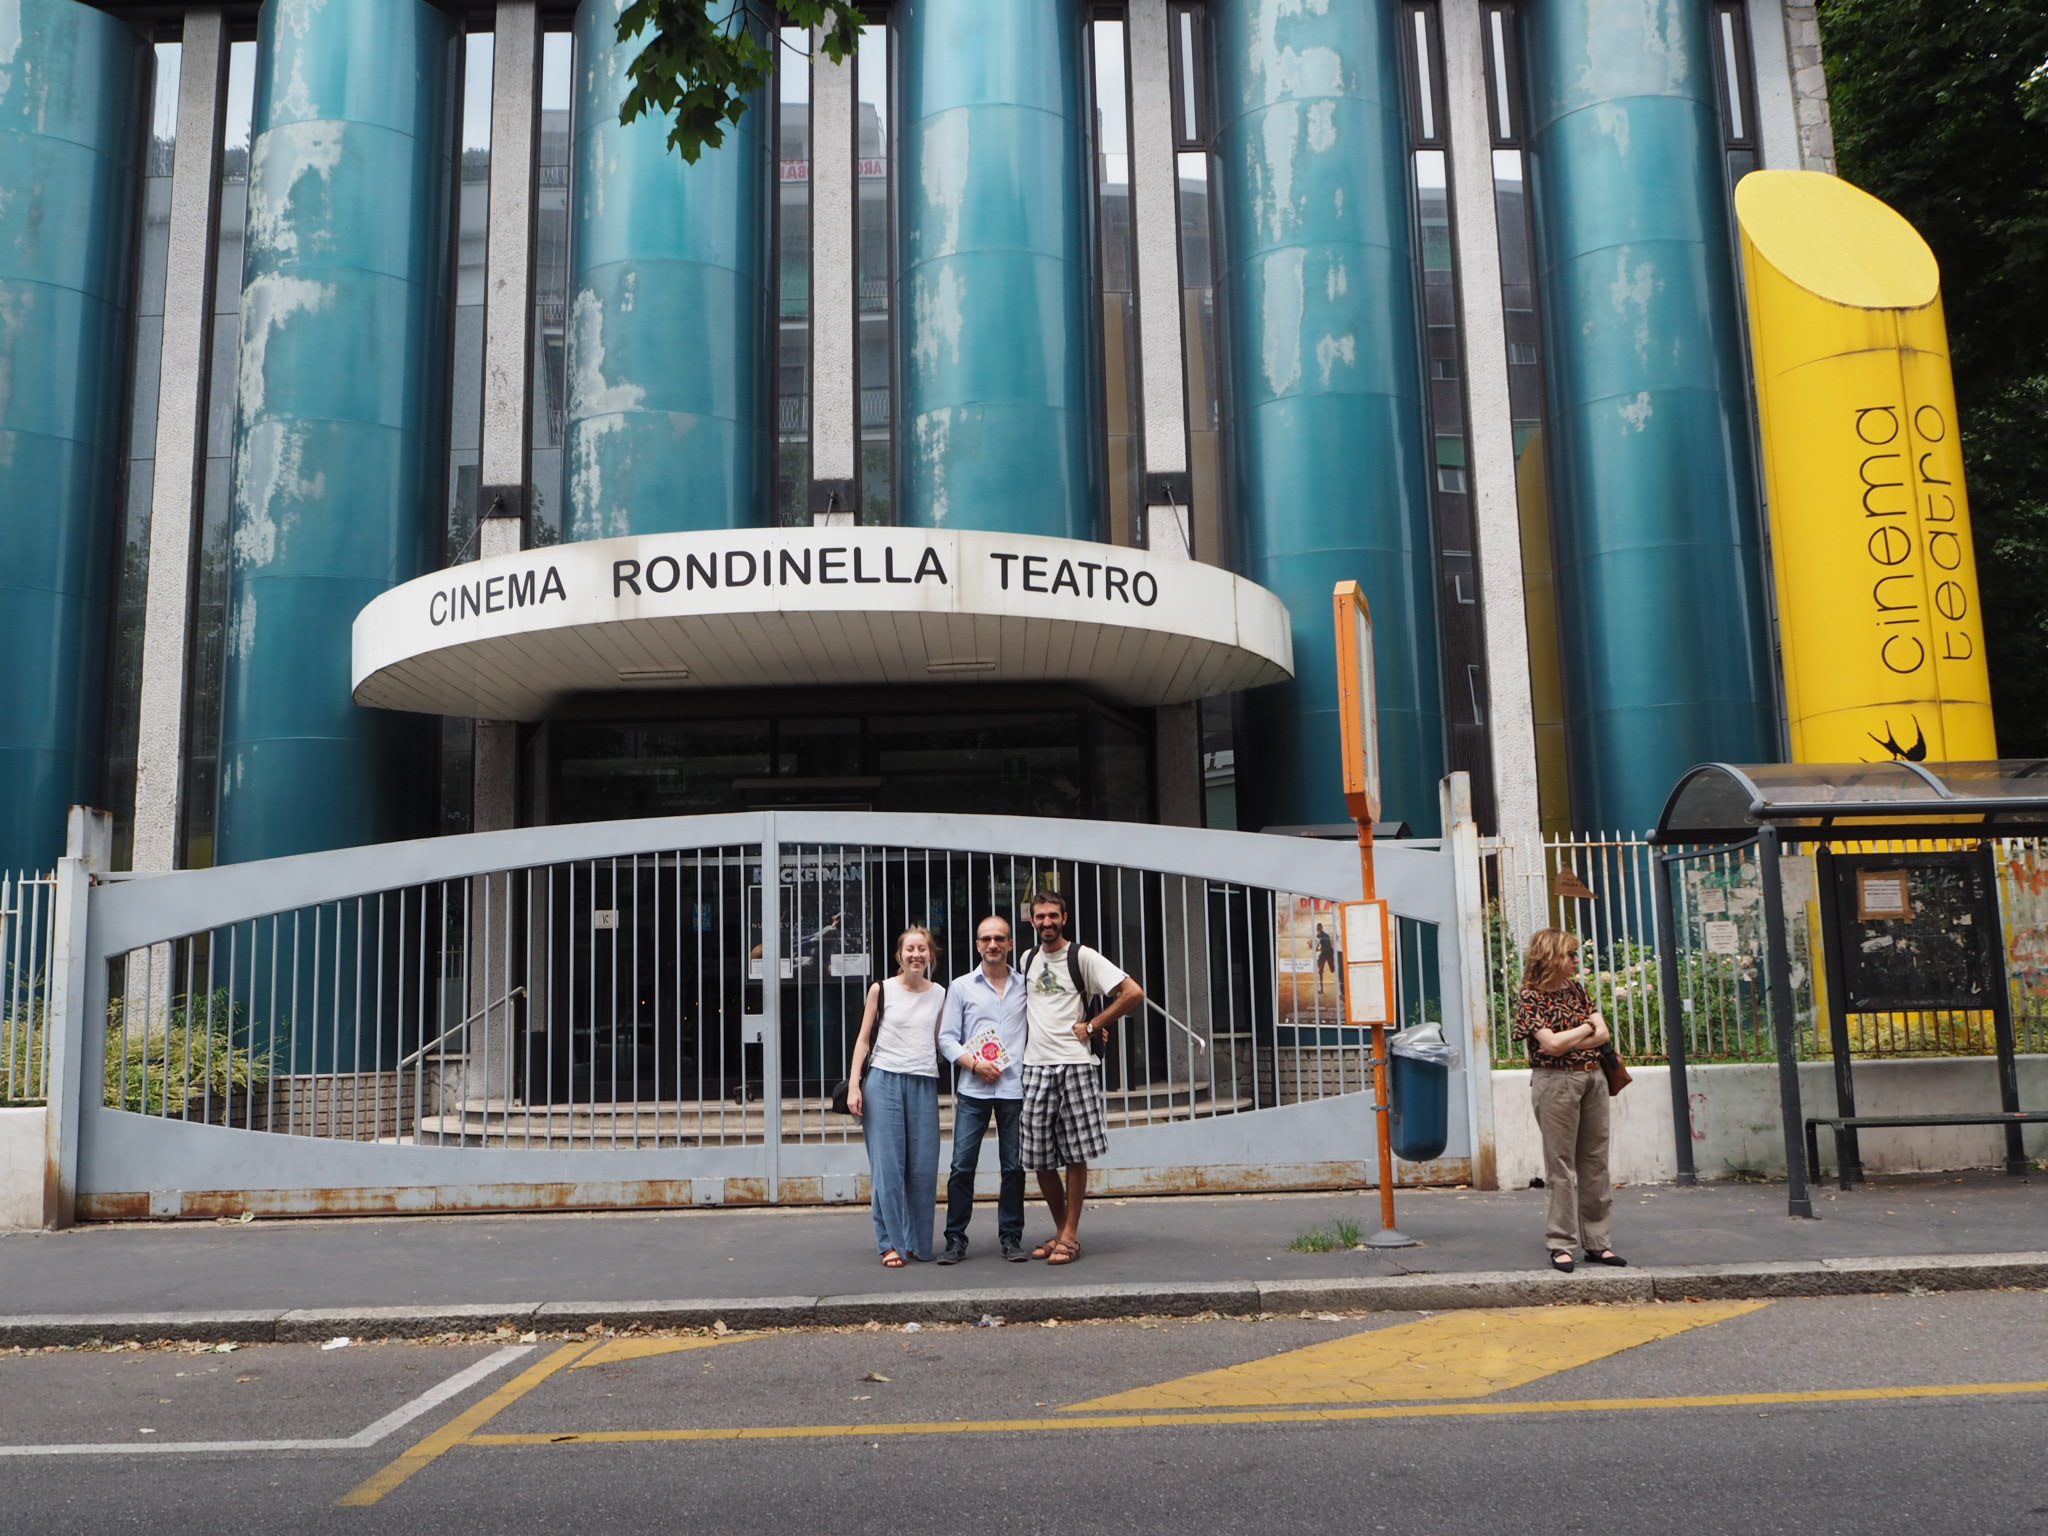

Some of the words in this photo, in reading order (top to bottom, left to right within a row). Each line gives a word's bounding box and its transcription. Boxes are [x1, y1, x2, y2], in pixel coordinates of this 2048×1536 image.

[429, 564, 567, 627] CINEMA
[613, 546, 949, 598] RONDINELLA
[990, 551, 1159, 607] TEATRO
[1855, 405, 1924, 674] cinema
[1914, 404, 1973, 661] teatro
[752, 866, 864, 884] RCKETMAN
